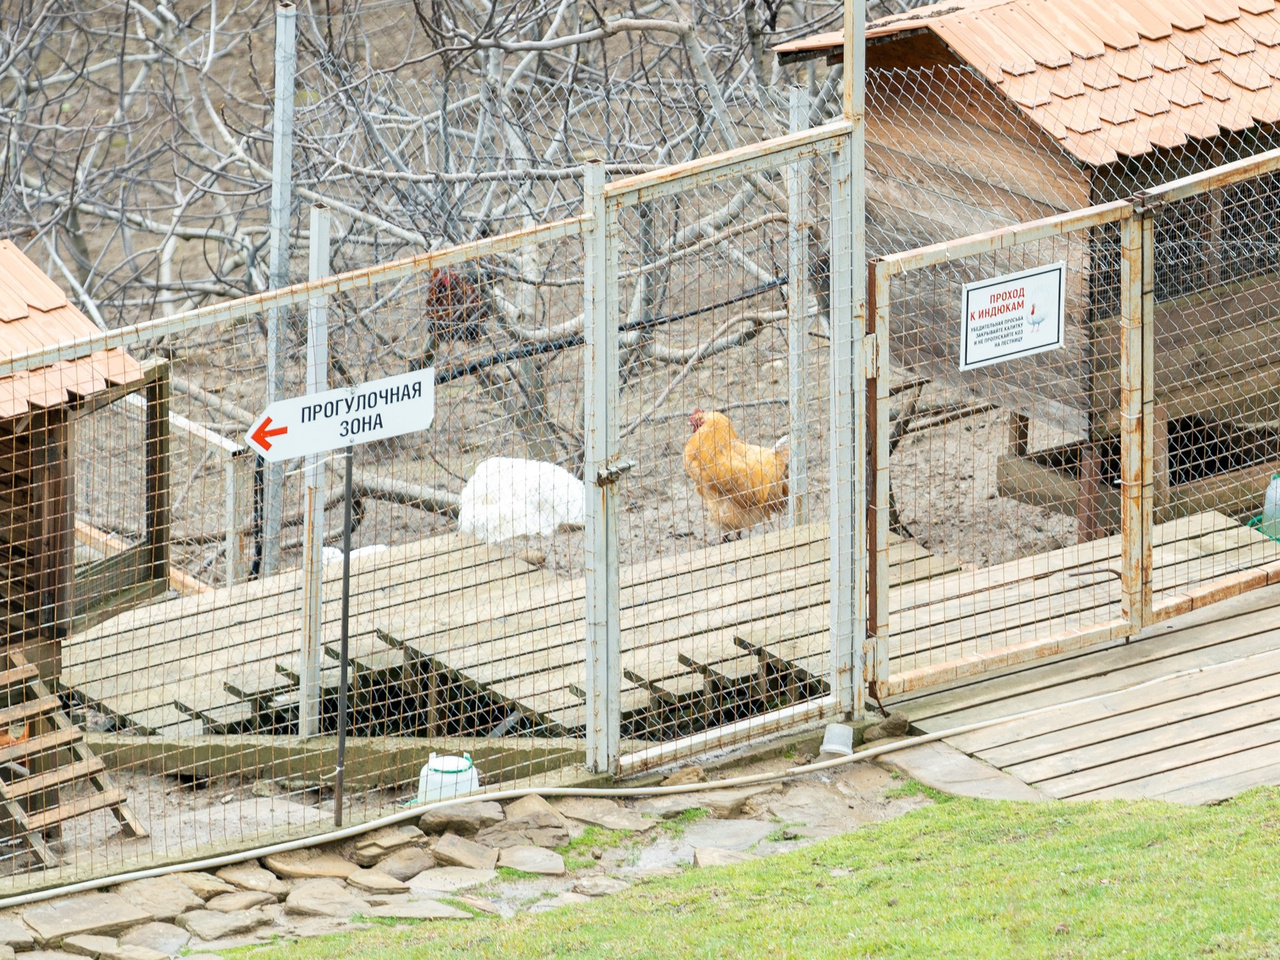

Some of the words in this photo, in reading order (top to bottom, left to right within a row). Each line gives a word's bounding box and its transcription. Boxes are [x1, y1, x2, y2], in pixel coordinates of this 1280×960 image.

[989, 287, 1025, 304] ПРОХОД
[970, 311, 976, 321] К
[978, 300, 1025, 319] ИНДЮКАМ
[970, 320, 1004, 333] УБЕДИТЕЛЬНАЯ
[1004, 315, 1024, 325] ПРОСЬБА
[975, 327, 1004, 339] ЗАКРЫВАЙТЕ
[1004, 322, 1024, 332] КАЛИТКУ
[301, 381, 422, 423] ПРОГУЛОЧНАЯ
[339, 413, 384, 437] ЗОНА
